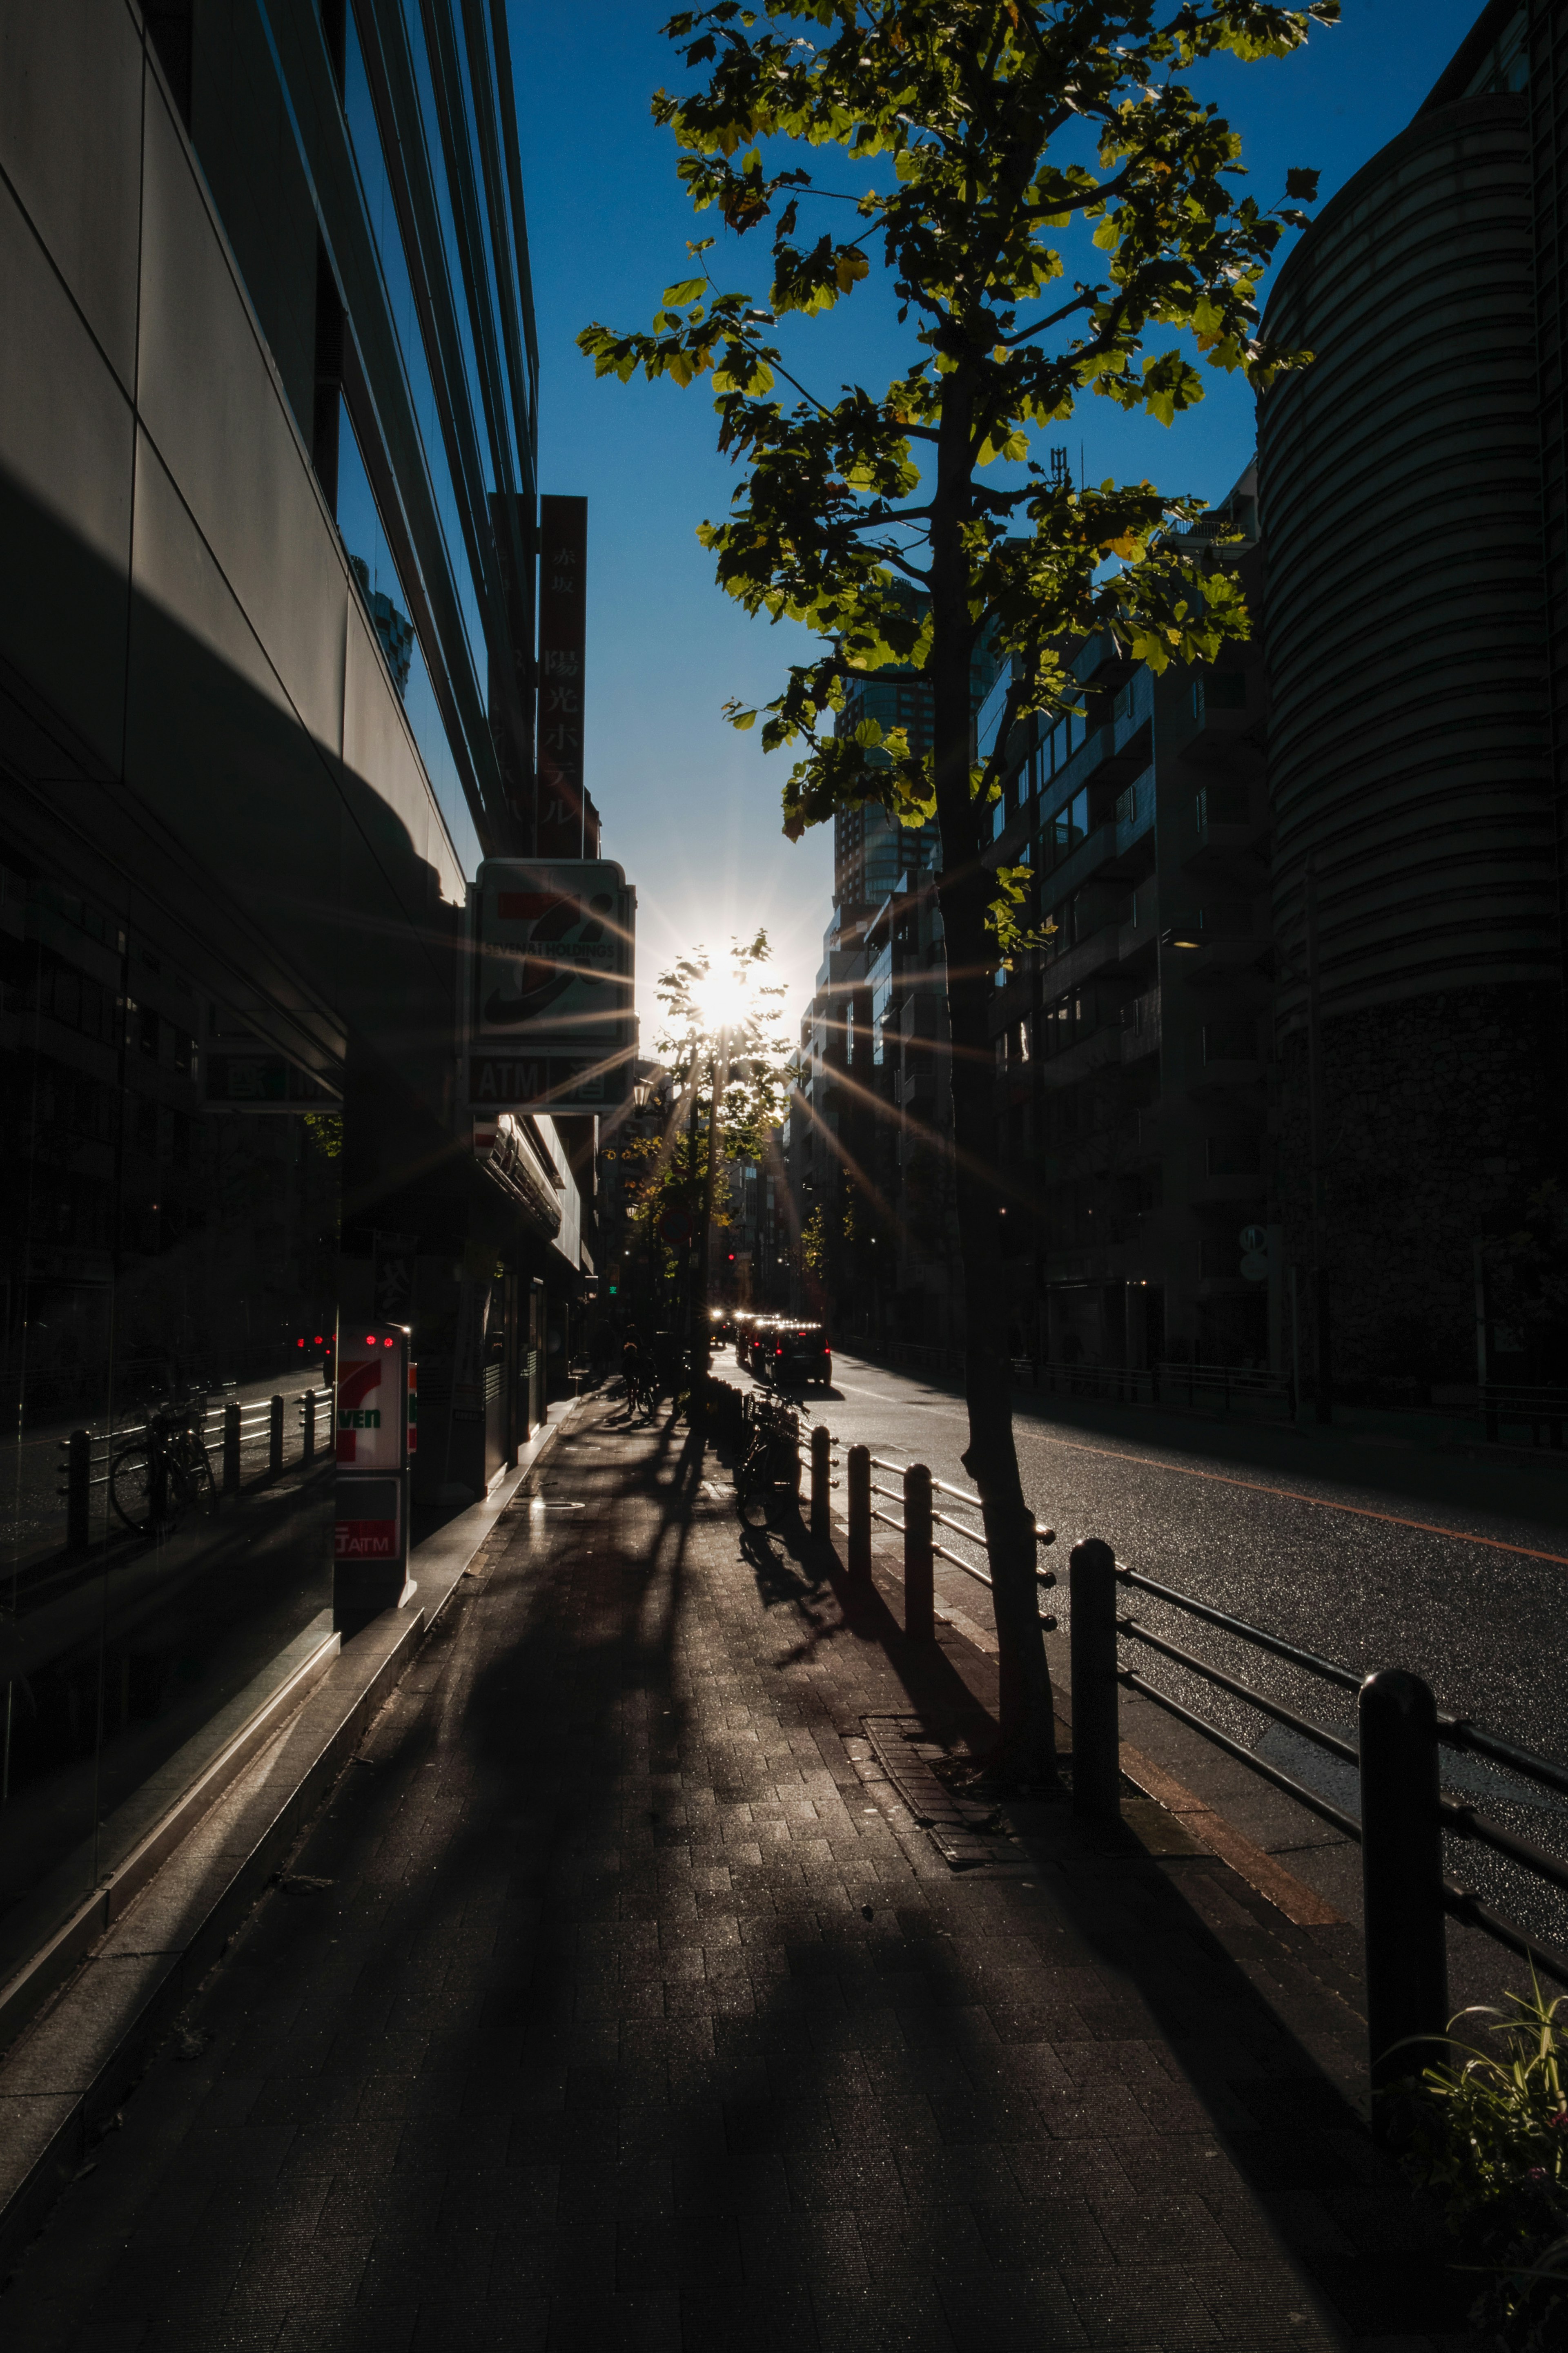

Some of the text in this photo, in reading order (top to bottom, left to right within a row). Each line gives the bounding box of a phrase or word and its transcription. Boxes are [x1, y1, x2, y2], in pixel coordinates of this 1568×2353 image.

[551, 547, 576, 594] 赤坂
[541, 649, 579, 825] 陽光ホテル
[546, 942, 615, 958] HOLDINGS
[478, 1062, 539, 1100] ATM
[568, 1062, 605, 1100] 酒
